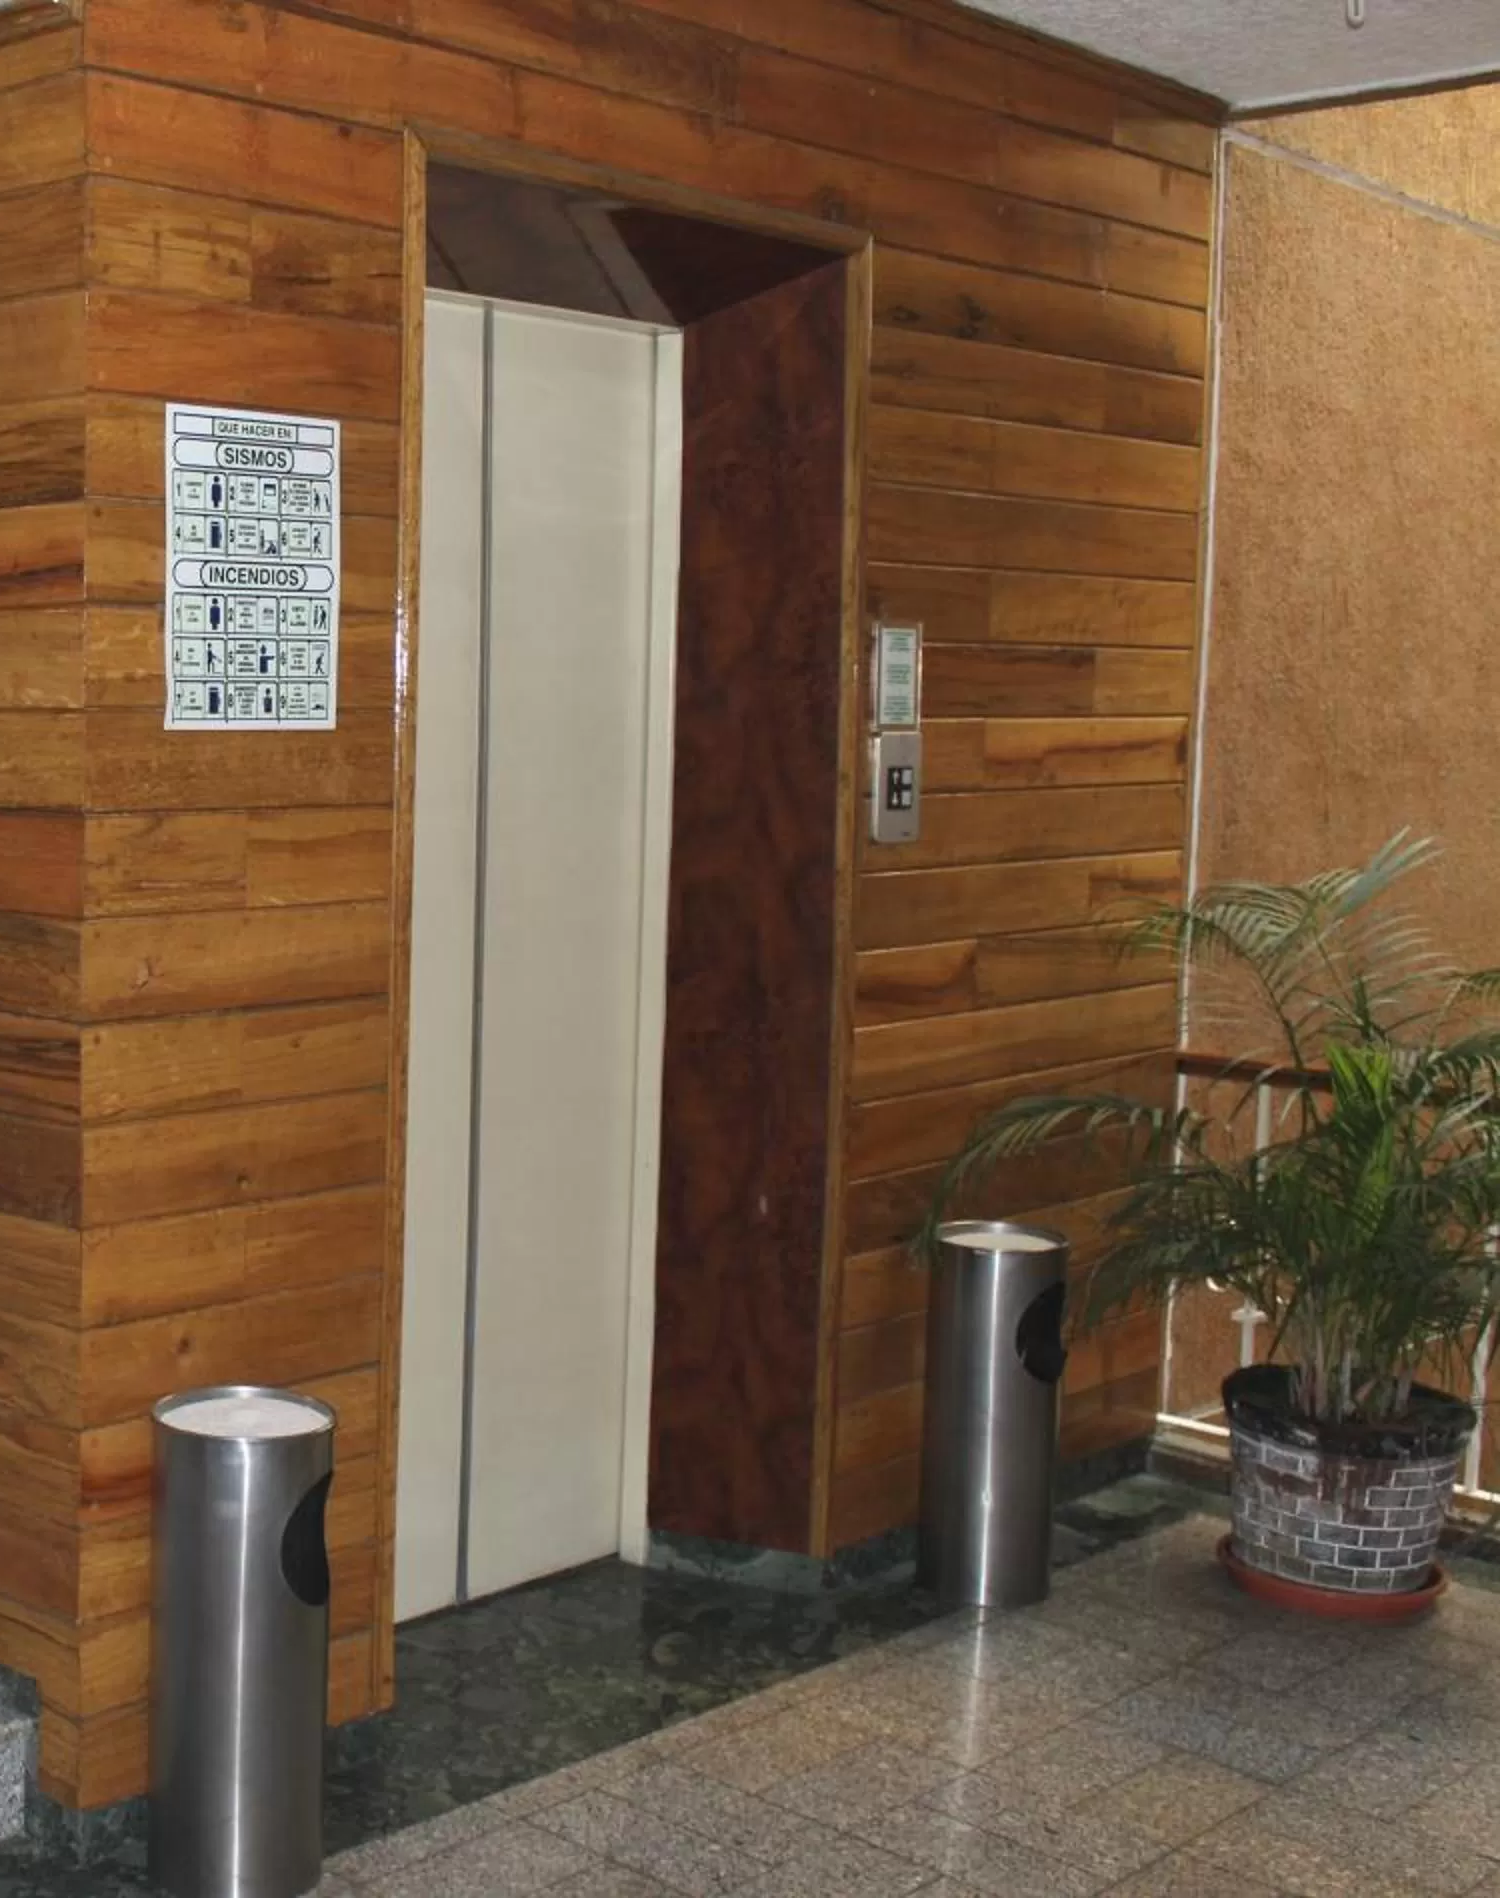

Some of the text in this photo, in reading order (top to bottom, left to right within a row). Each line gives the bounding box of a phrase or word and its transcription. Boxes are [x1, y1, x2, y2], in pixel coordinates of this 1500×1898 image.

[218, 422, 239, 434] QUE
[241, 423, 275, 437] HACER
[223, 447, 287, 468] SISMOS
[208, 567, 300, 586] INCENDIOS
